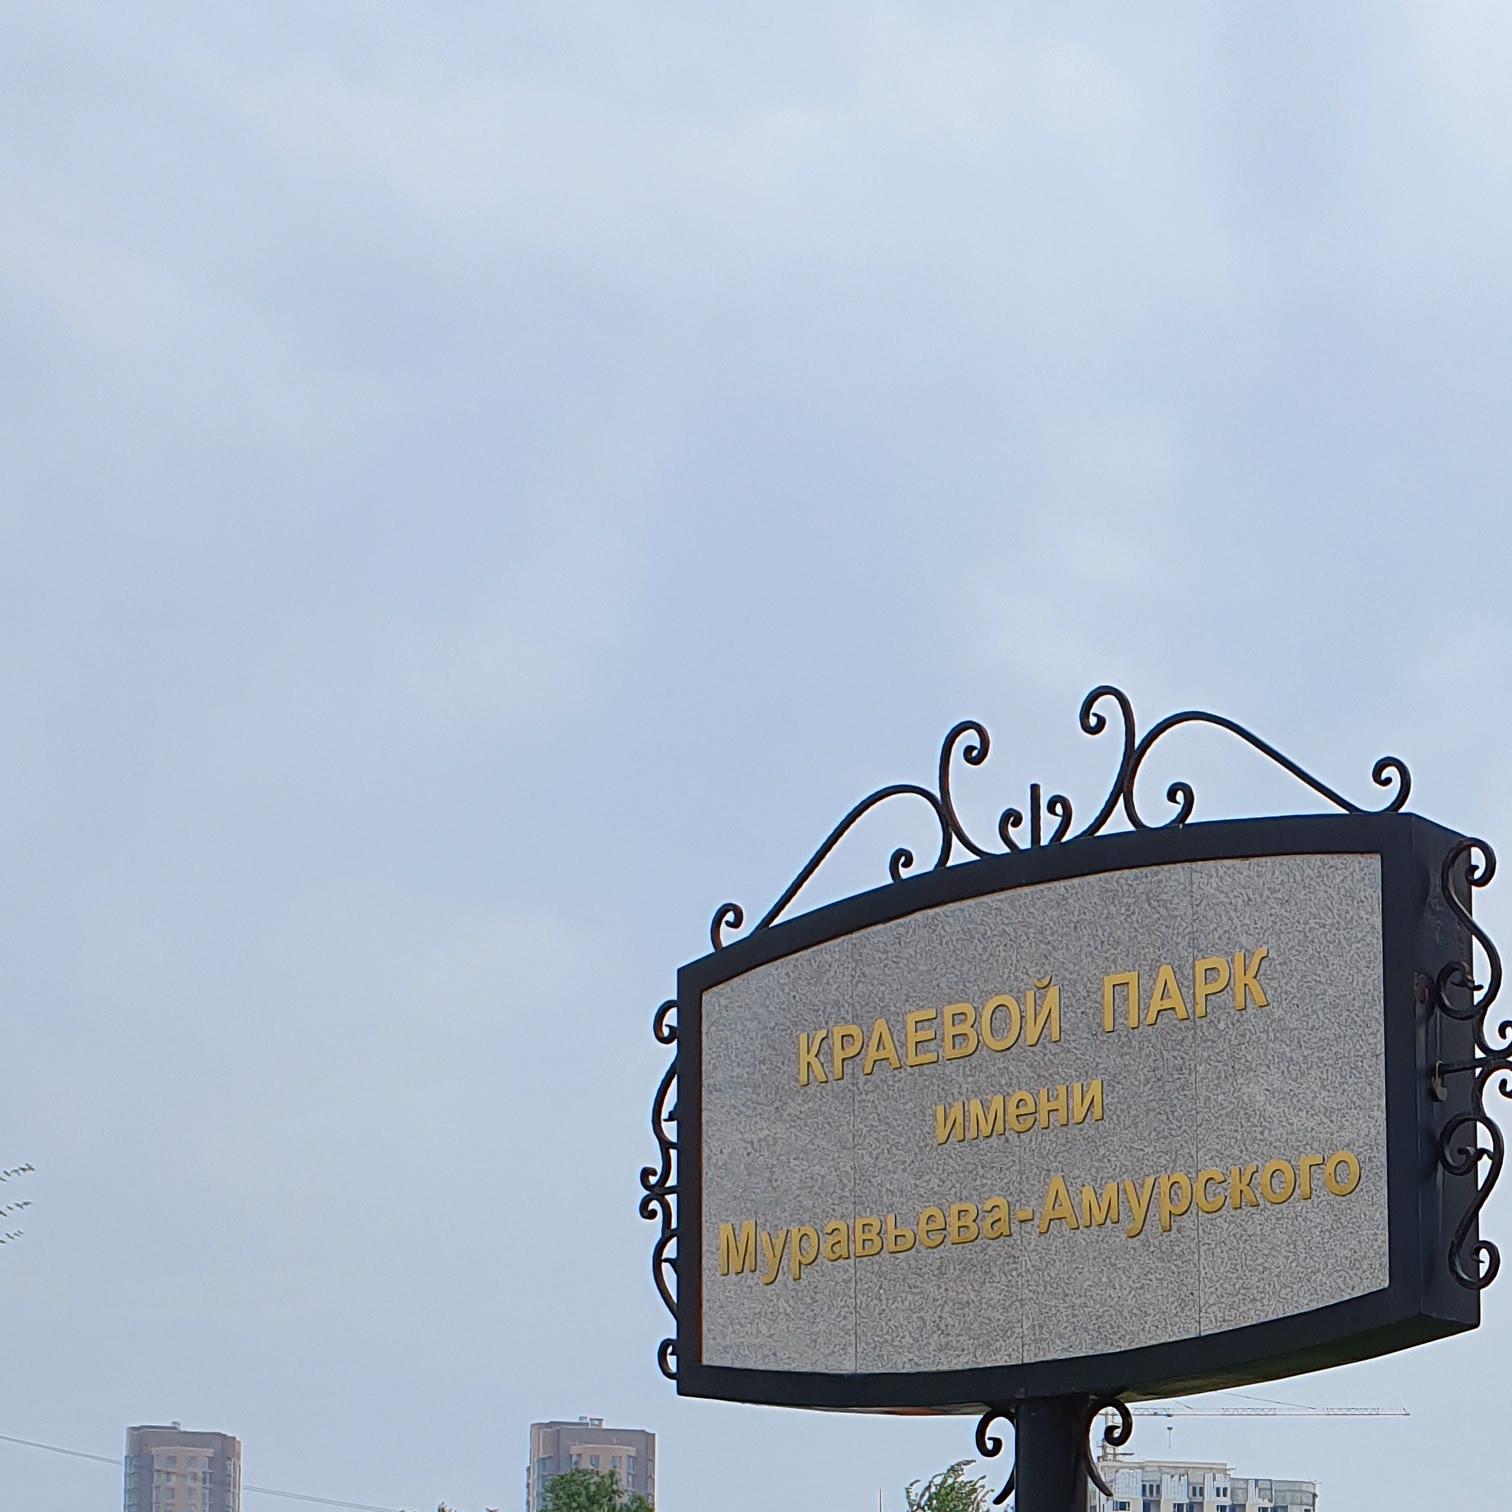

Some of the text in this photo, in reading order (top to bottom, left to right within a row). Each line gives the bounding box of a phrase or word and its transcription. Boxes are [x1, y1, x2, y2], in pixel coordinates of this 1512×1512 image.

[797, 946, 1271, 1086] КРАЕВОЙ ПАРК
[934, 1078, 1105, 1145] имени
[718, 1150, 1361, 1287] Муравьева-Амурского
